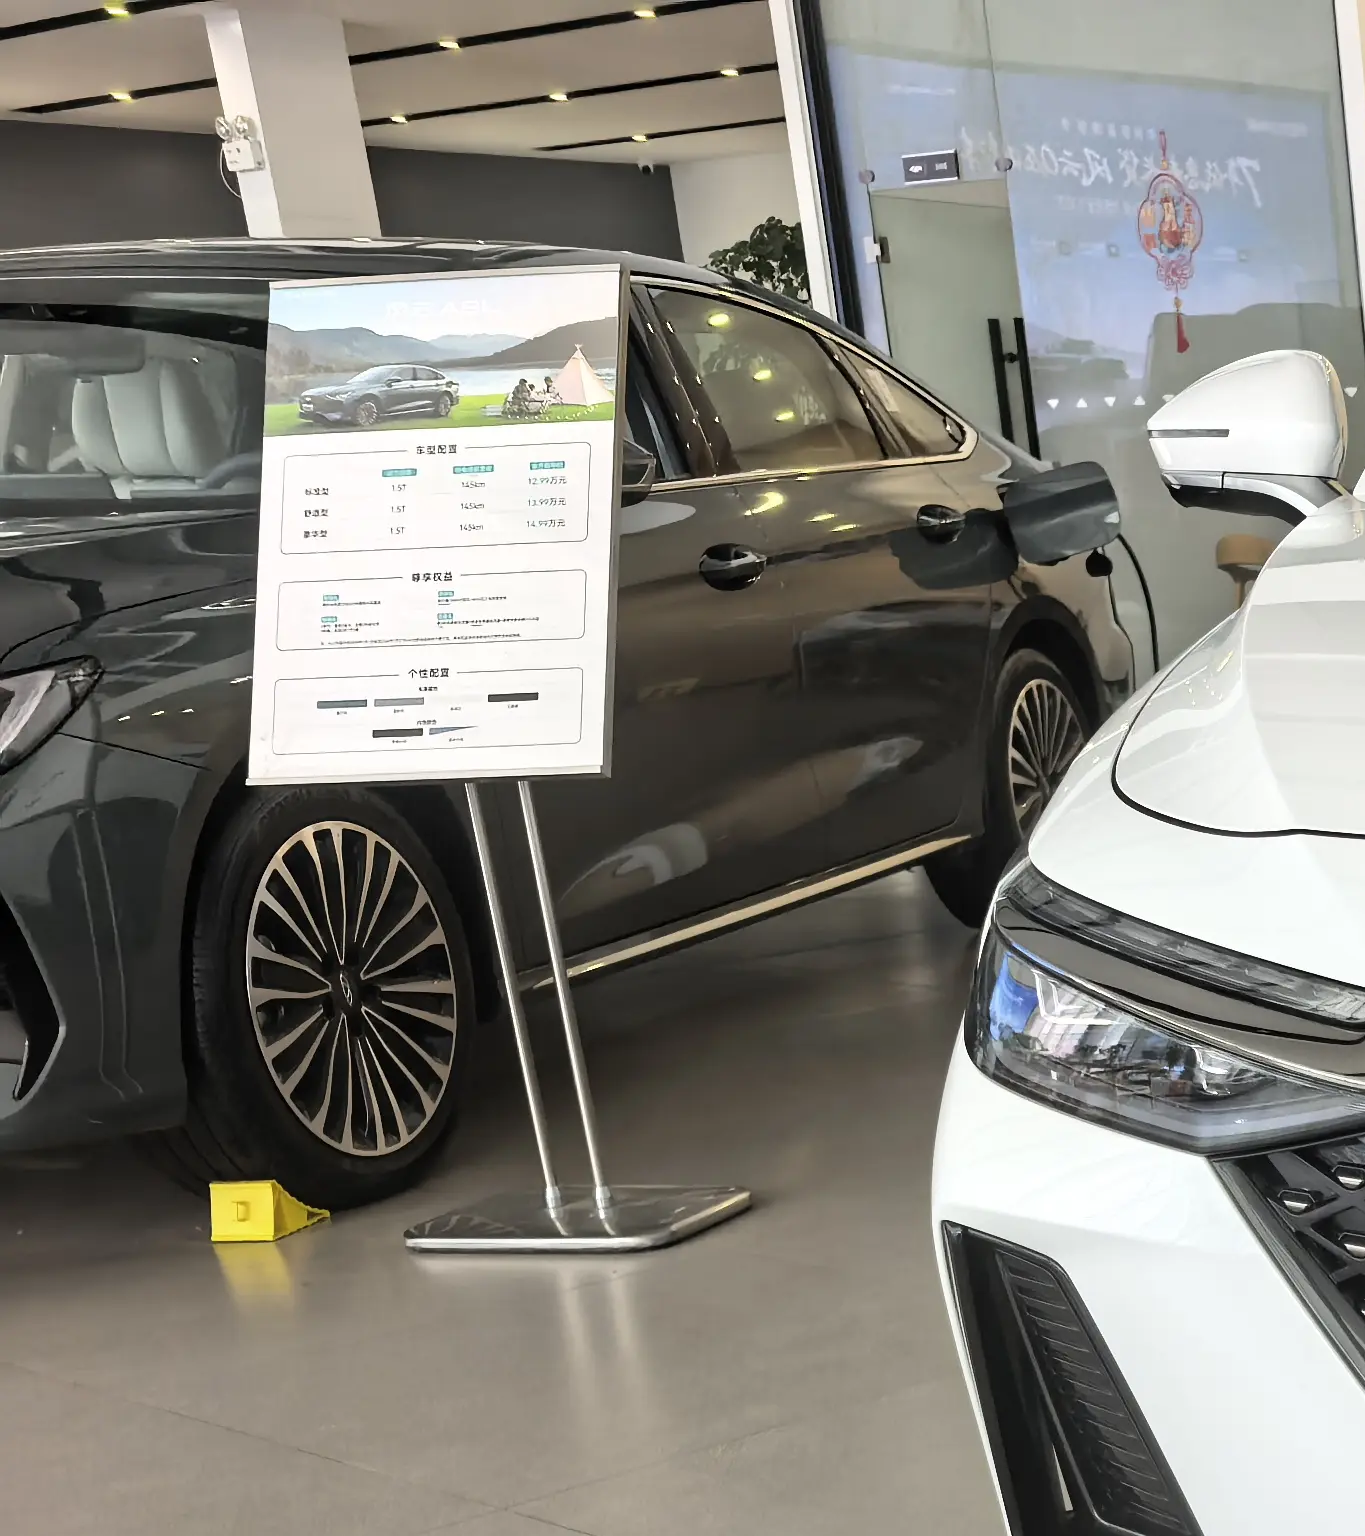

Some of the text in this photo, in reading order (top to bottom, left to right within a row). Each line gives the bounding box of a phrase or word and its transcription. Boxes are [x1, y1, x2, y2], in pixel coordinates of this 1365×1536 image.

[416, 444, 458, 455] 车型配置
[411, 571, 454, 582] 尊享权益
[408, 668, 450, 679] 个性配置
